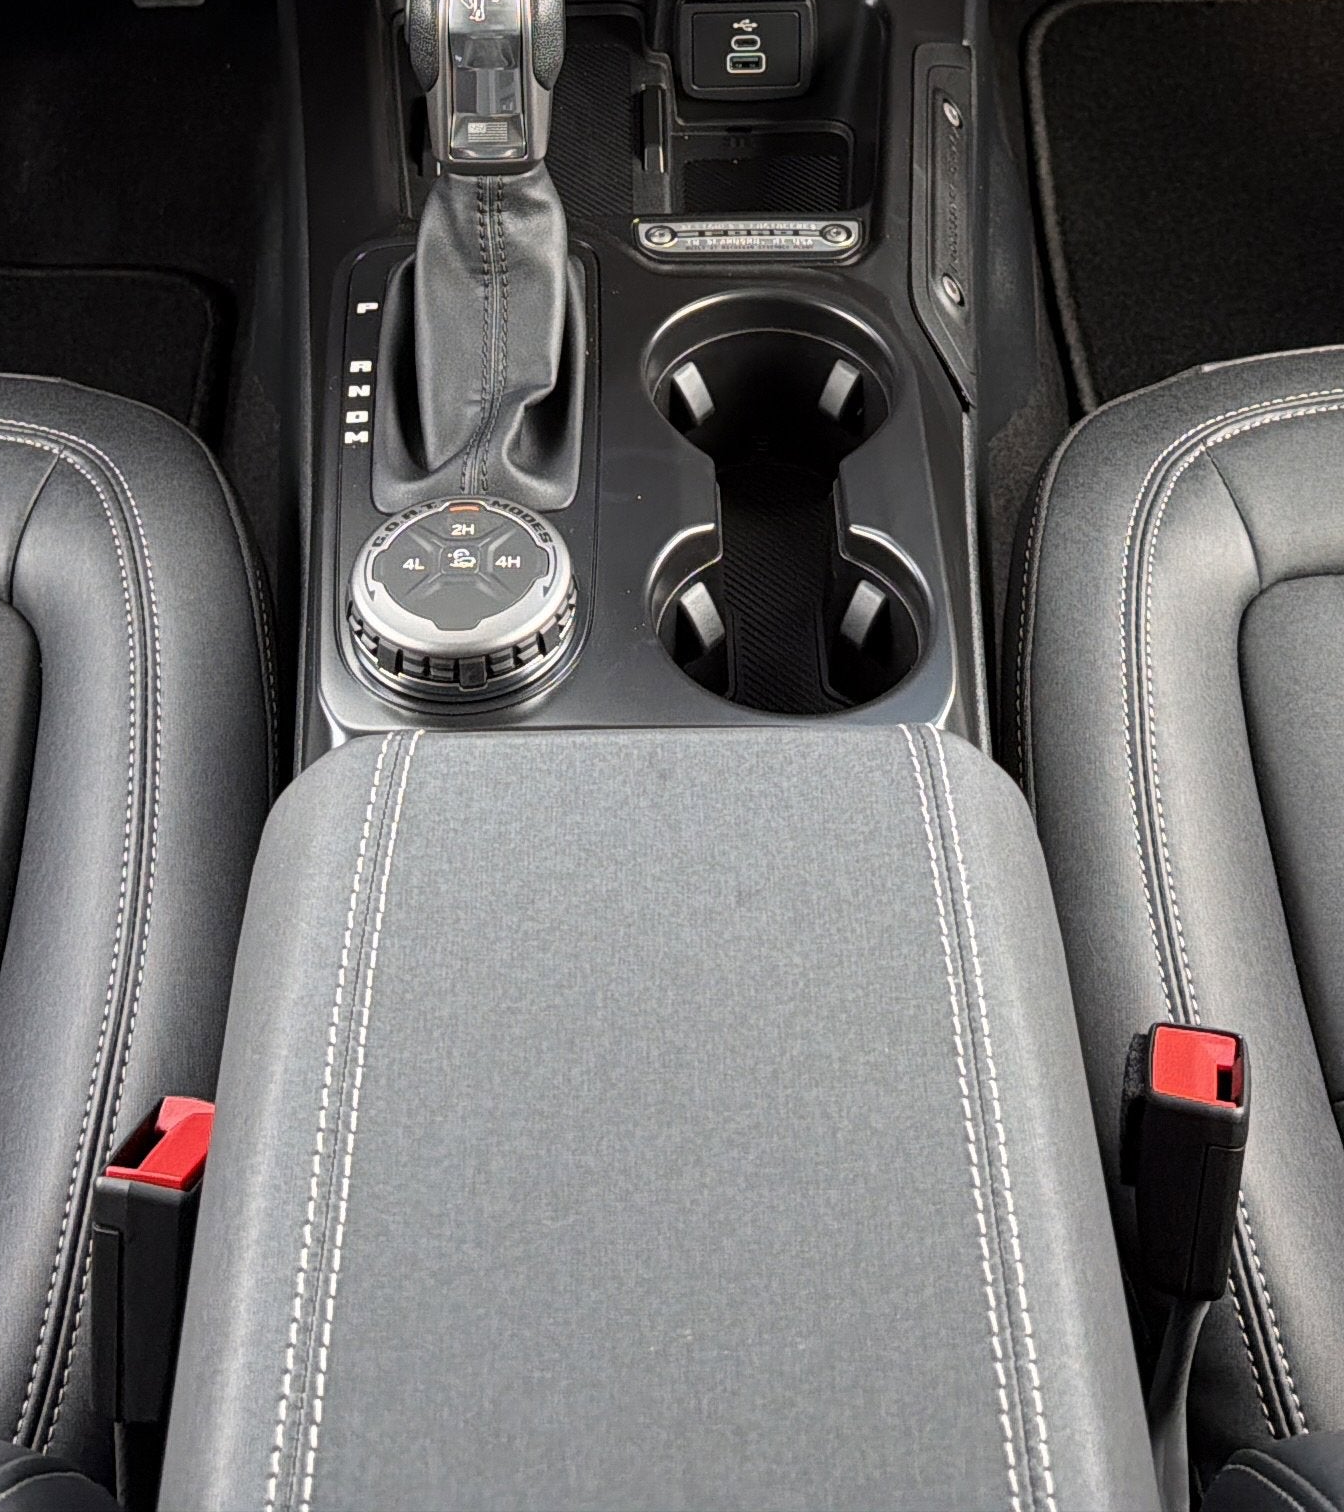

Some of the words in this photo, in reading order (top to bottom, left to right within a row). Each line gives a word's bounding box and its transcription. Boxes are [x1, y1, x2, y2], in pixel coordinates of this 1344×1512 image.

[356, 302, 379, 314] P
[349, 360, 373, 373] R
[348, 384, 371, 398] N
[346, 410, 369, 424] D
[344, 430, 369, 444] M
[372, 500, 438, 548] G.O.A.T.
[491, 499, 554, 544] MODES
[451, 523, 475, 536] 2H
[403, 558, 425, 571] 4L
[495, 555, 521, 569] 4H
